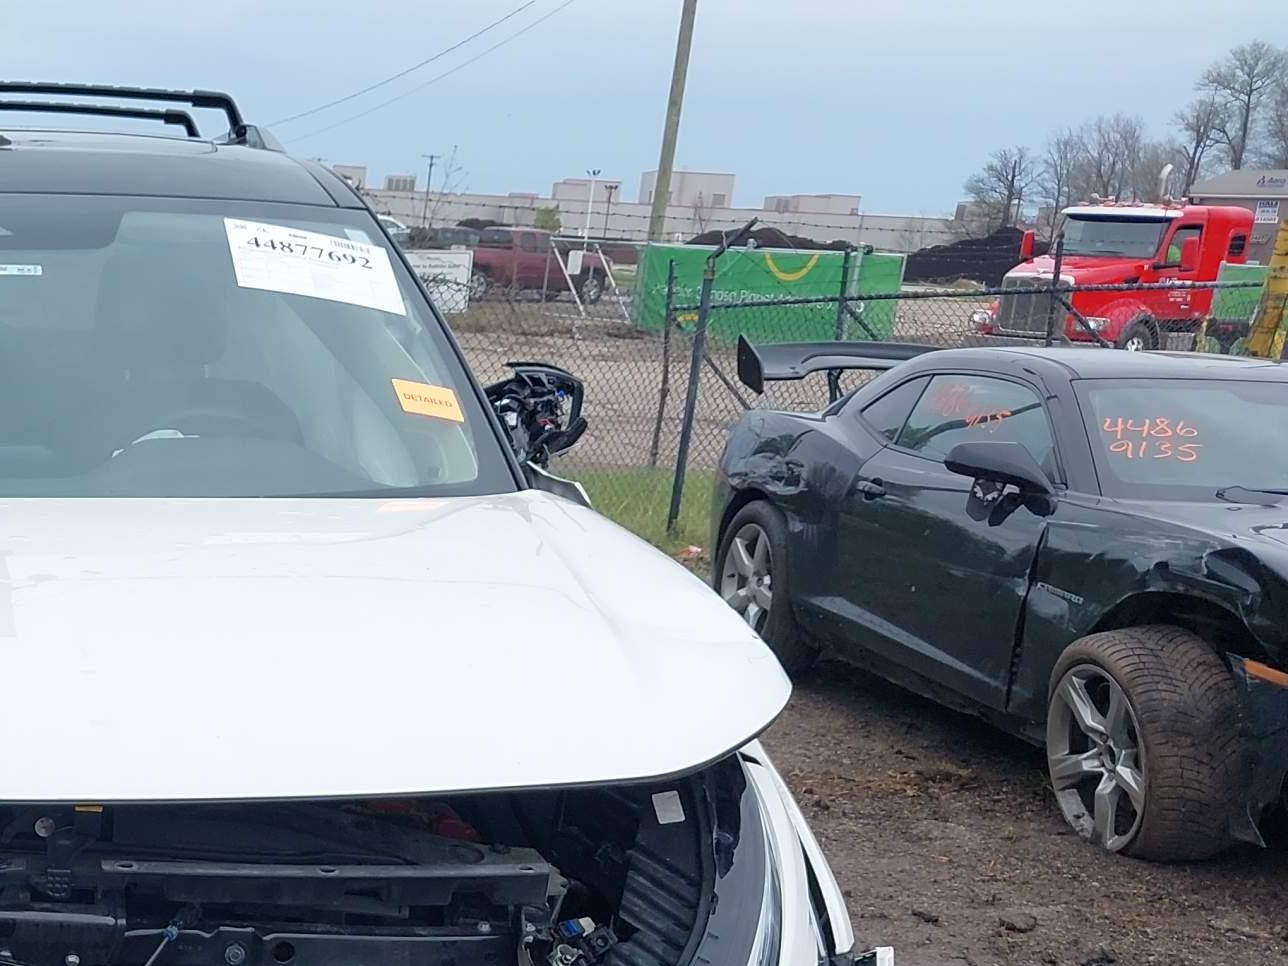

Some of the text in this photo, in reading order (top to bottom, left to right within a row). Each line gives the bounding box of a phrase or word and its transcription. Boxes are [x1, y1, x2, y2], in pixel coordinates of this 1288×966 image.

[246, 236, 373, 270] 44877692
[402, 392, 453, 408] DETAILED
[1103, 416, 1198, 440] 4486
[1109, 440, 1204, 462] 9135
